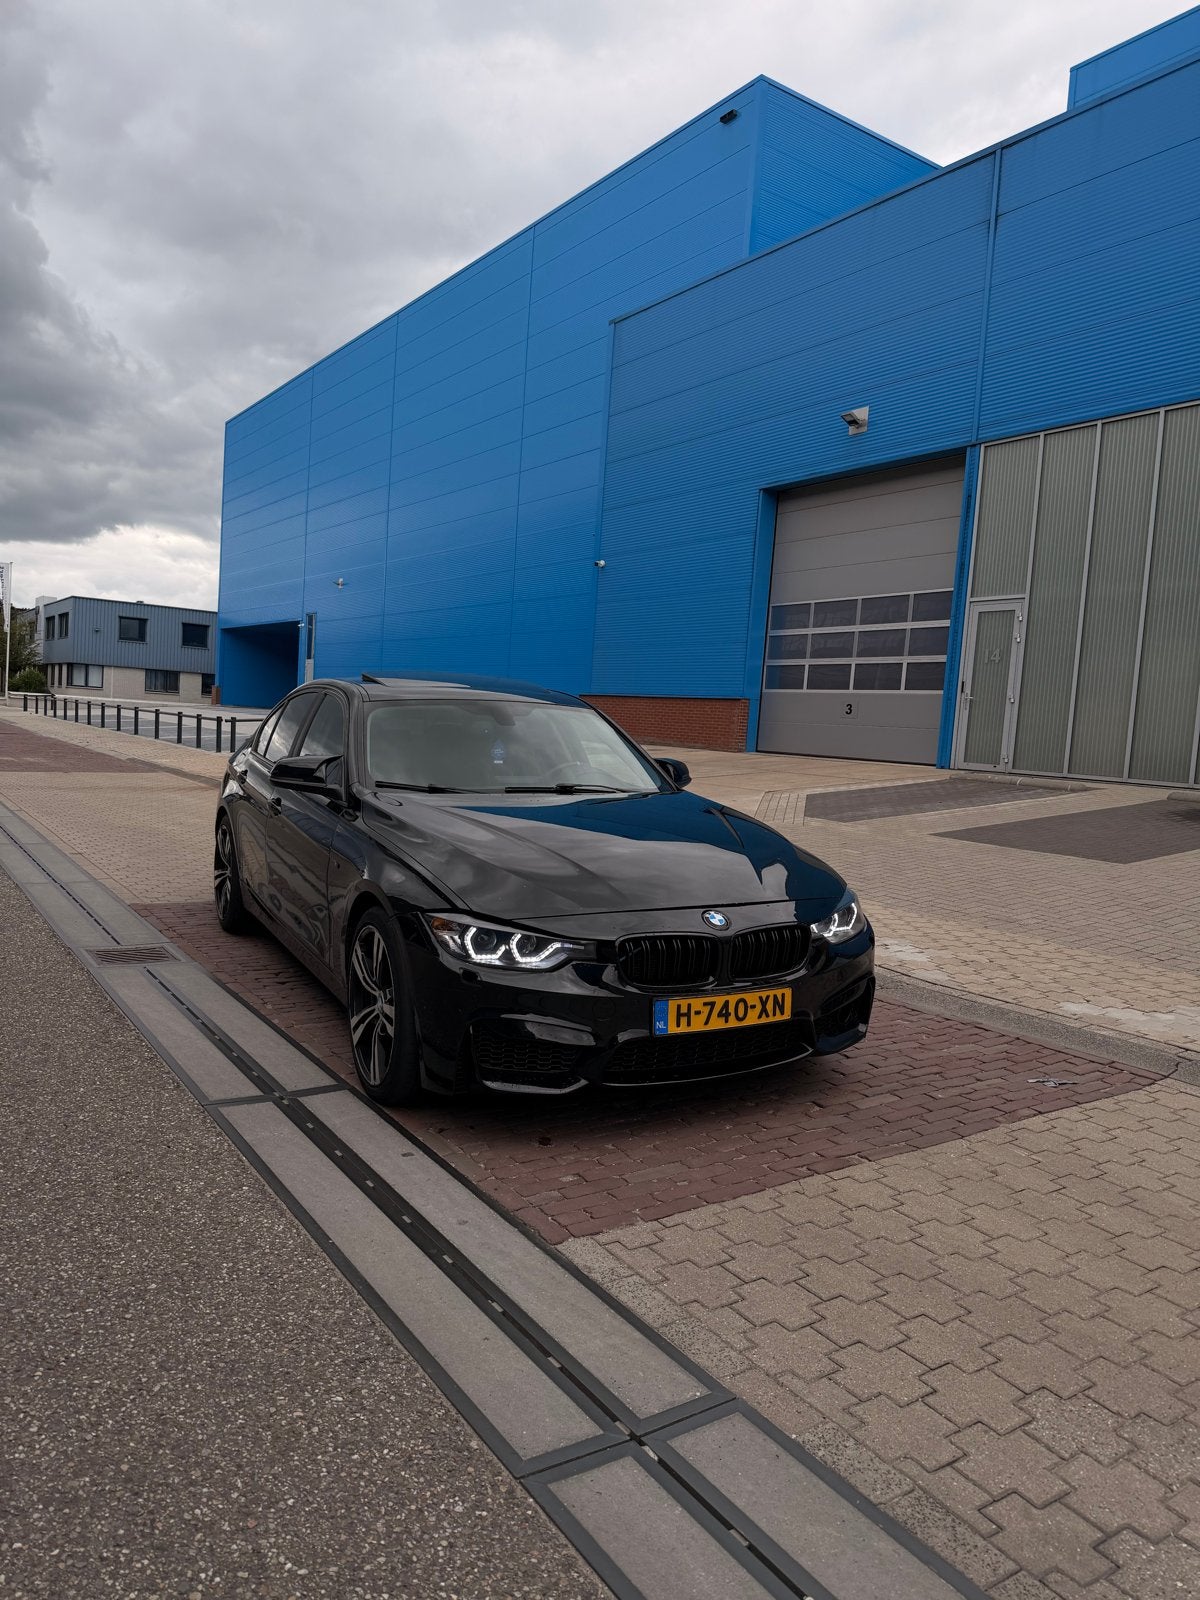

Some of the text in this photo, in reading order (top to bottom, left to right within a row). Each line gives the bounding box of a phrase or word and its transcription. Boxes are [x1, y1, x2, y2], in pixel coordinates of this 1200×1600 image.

[984, 648, 1000, 664] 14
[845, 703, 853, 715] 3
[675, 993, 785, 1028] H-740-XN
[656, 1021, 666, 1029] NL
